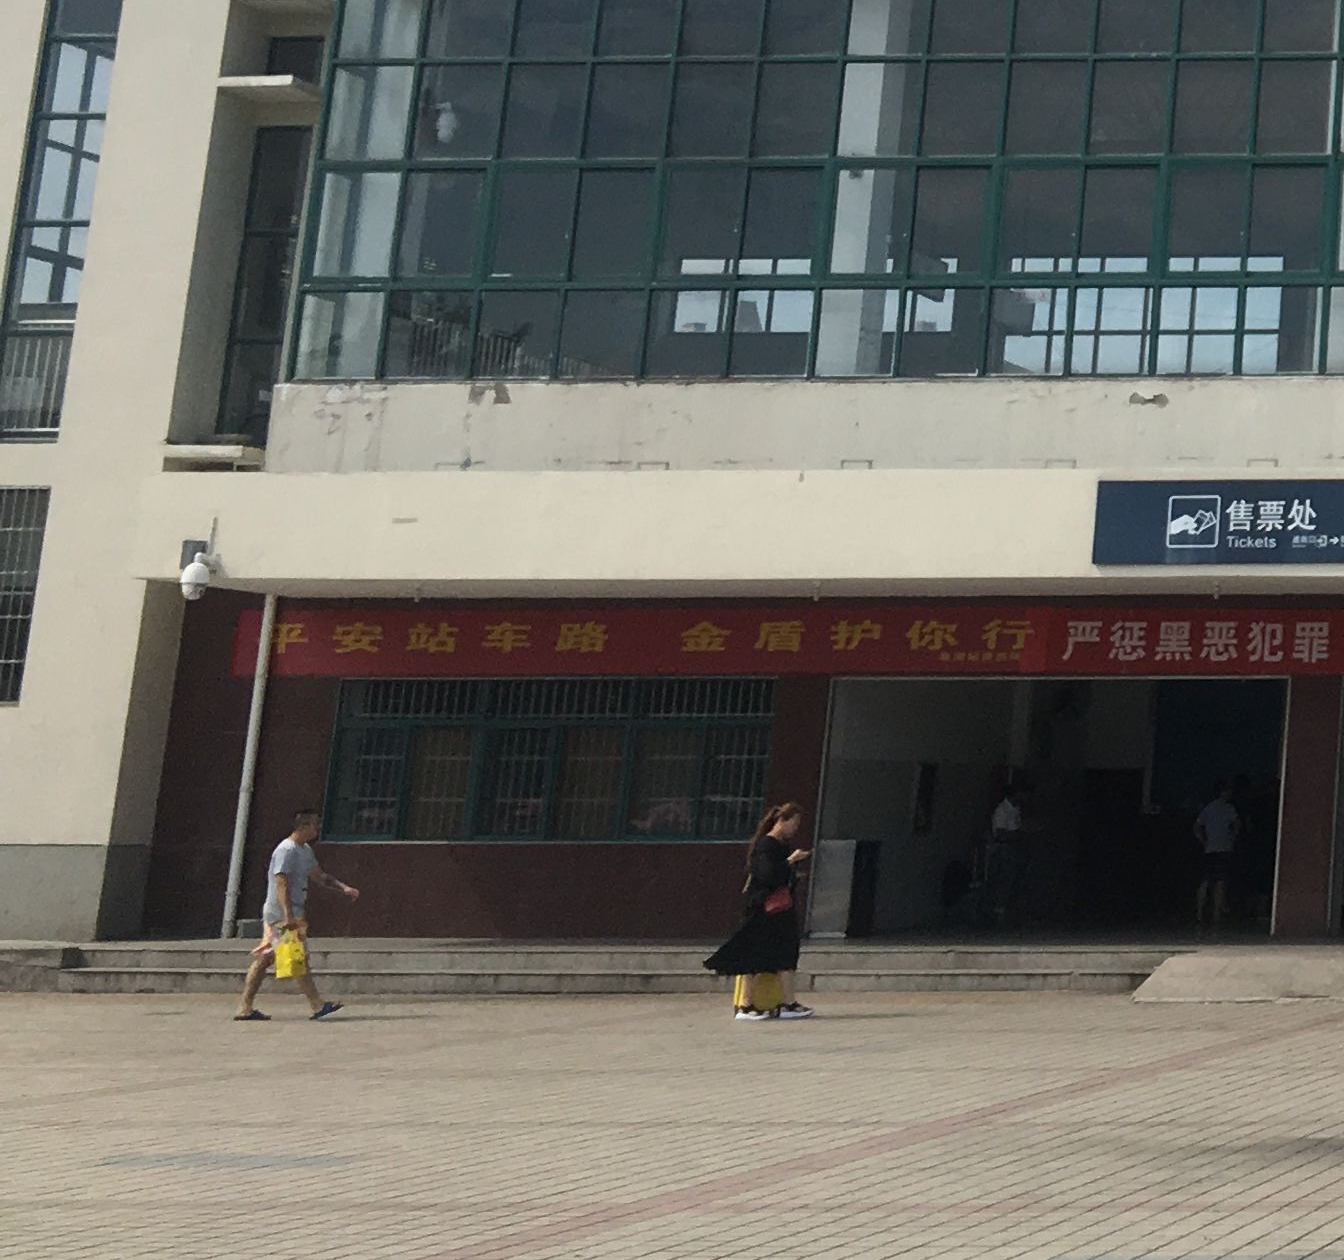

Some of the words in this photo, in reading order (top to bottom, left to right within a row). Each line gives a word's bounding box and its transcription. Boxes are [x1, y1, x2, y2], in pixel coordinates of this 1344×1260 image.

[1225, 499, 1318, 532] 售票处
[1226, 536, 1277, 548] Tickets
[272, 621, 609, 653] 平安站车路
[680, 619, 1036, 652] 金盾护你行
[1061, 619, 1331, 663] 严惩黑恶犯罪
